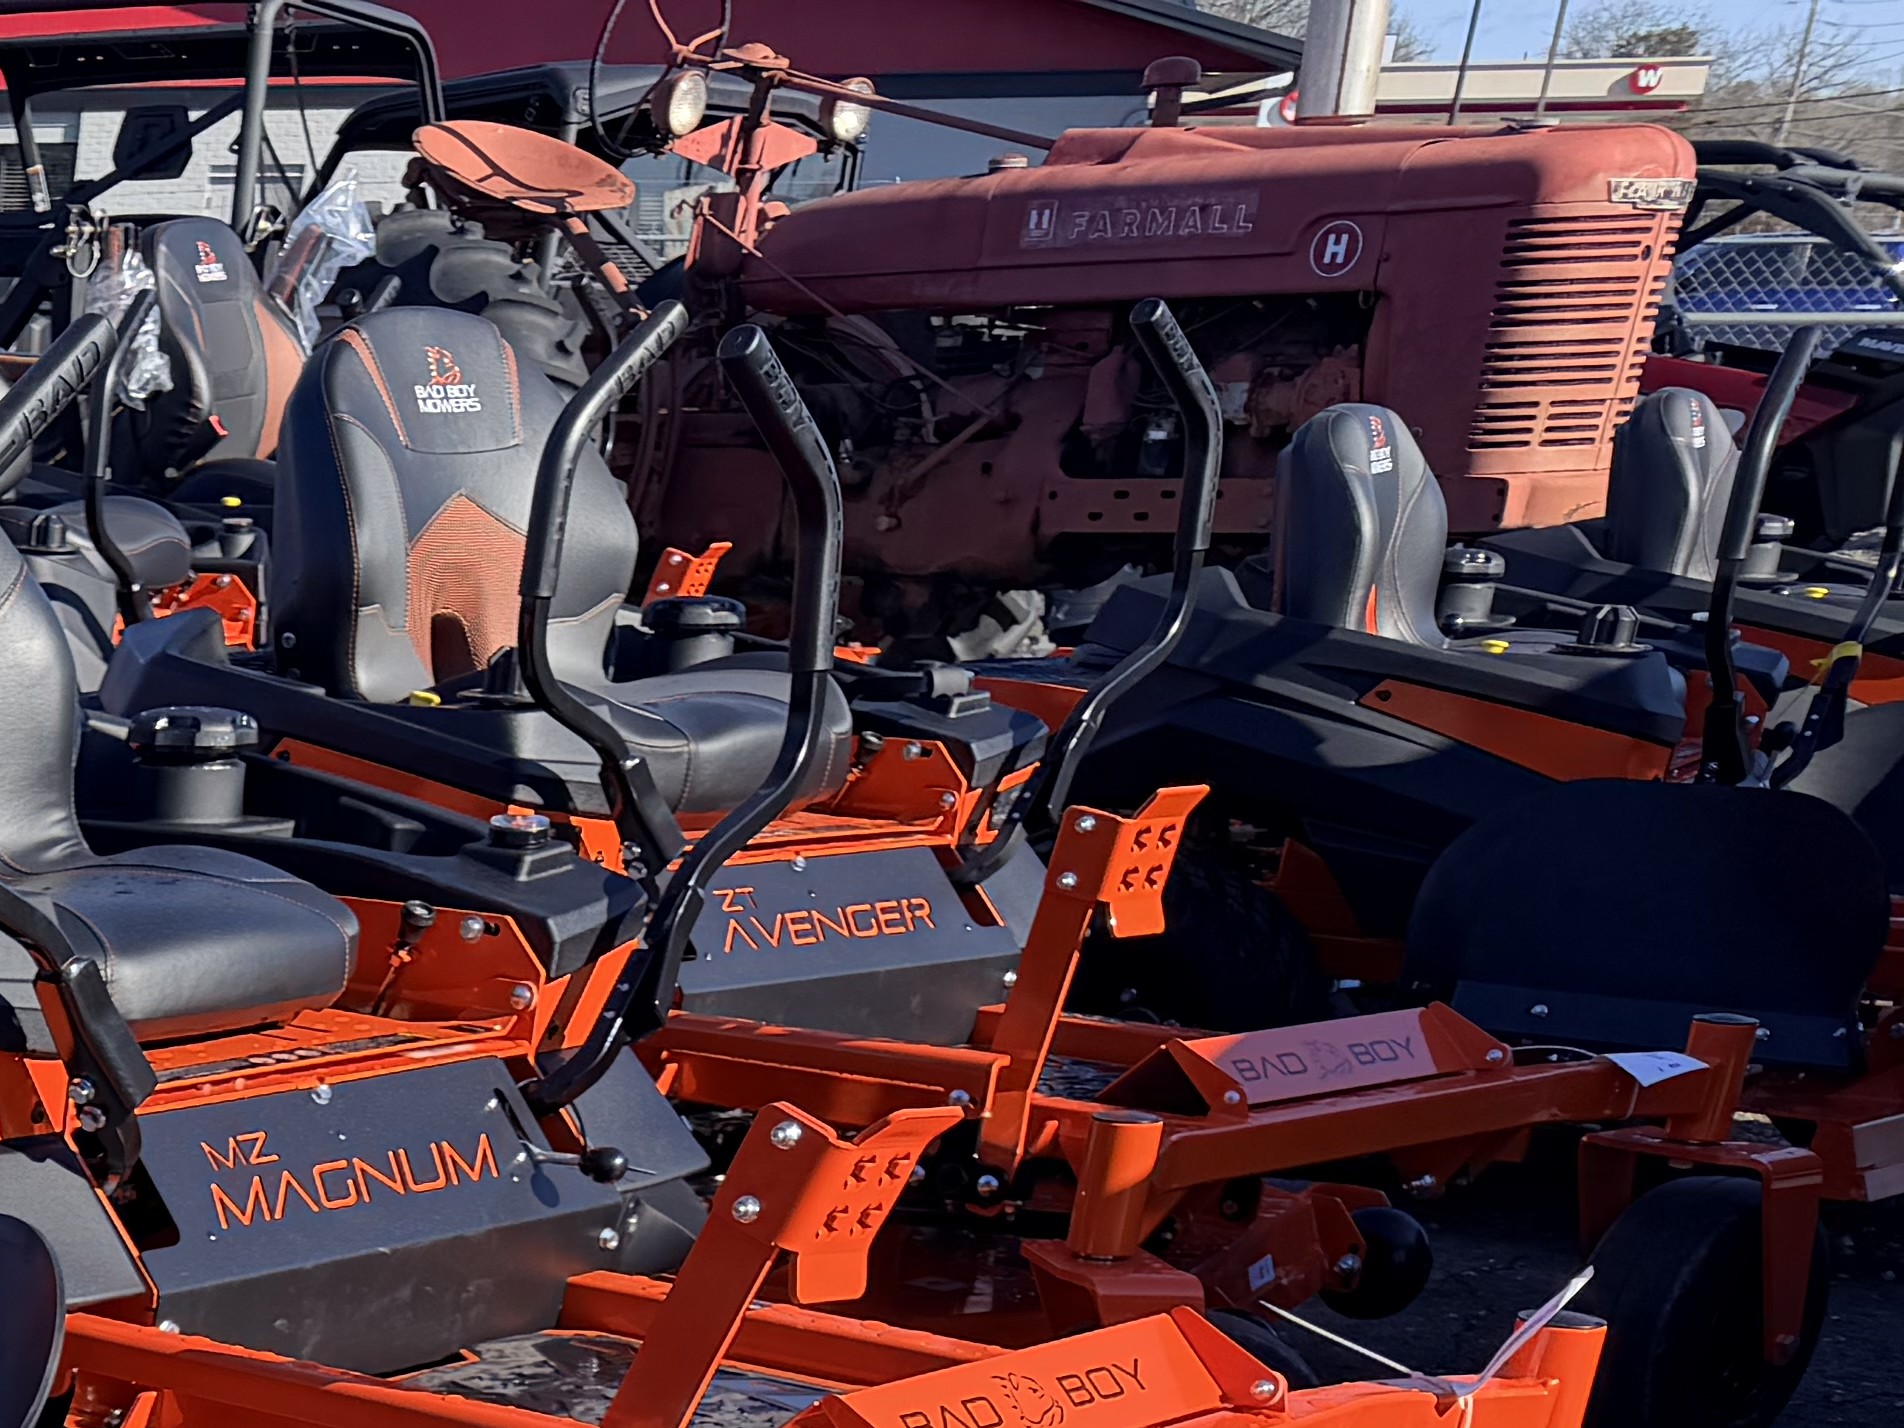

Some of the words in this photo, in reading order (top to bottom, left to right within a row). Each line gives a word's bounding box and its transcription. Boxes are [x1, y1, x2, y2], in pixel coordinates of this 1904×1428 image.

[1637, 69, 1663, 87] W
[1068, 204, 1253, 240] FARMALL
[1322, 233, 1349, 264] H
[415, 385, 444, 399] BAD
[447, 384, 476, 398] BOY
[416, 397, 482, 413] MOWERS
[713, 886, 755, 914] ZT
[723, 895, 938, 954] AVENGER
[1229, 1048, 1309, 1085] BAD
[1352, 1030, 1417, 1071] BOY
[200, 1131, 280, 1172] MZ
[210, 1132, 500, 1232] MAGNUM
[1063, 1357, 1145, 1408] BOY
